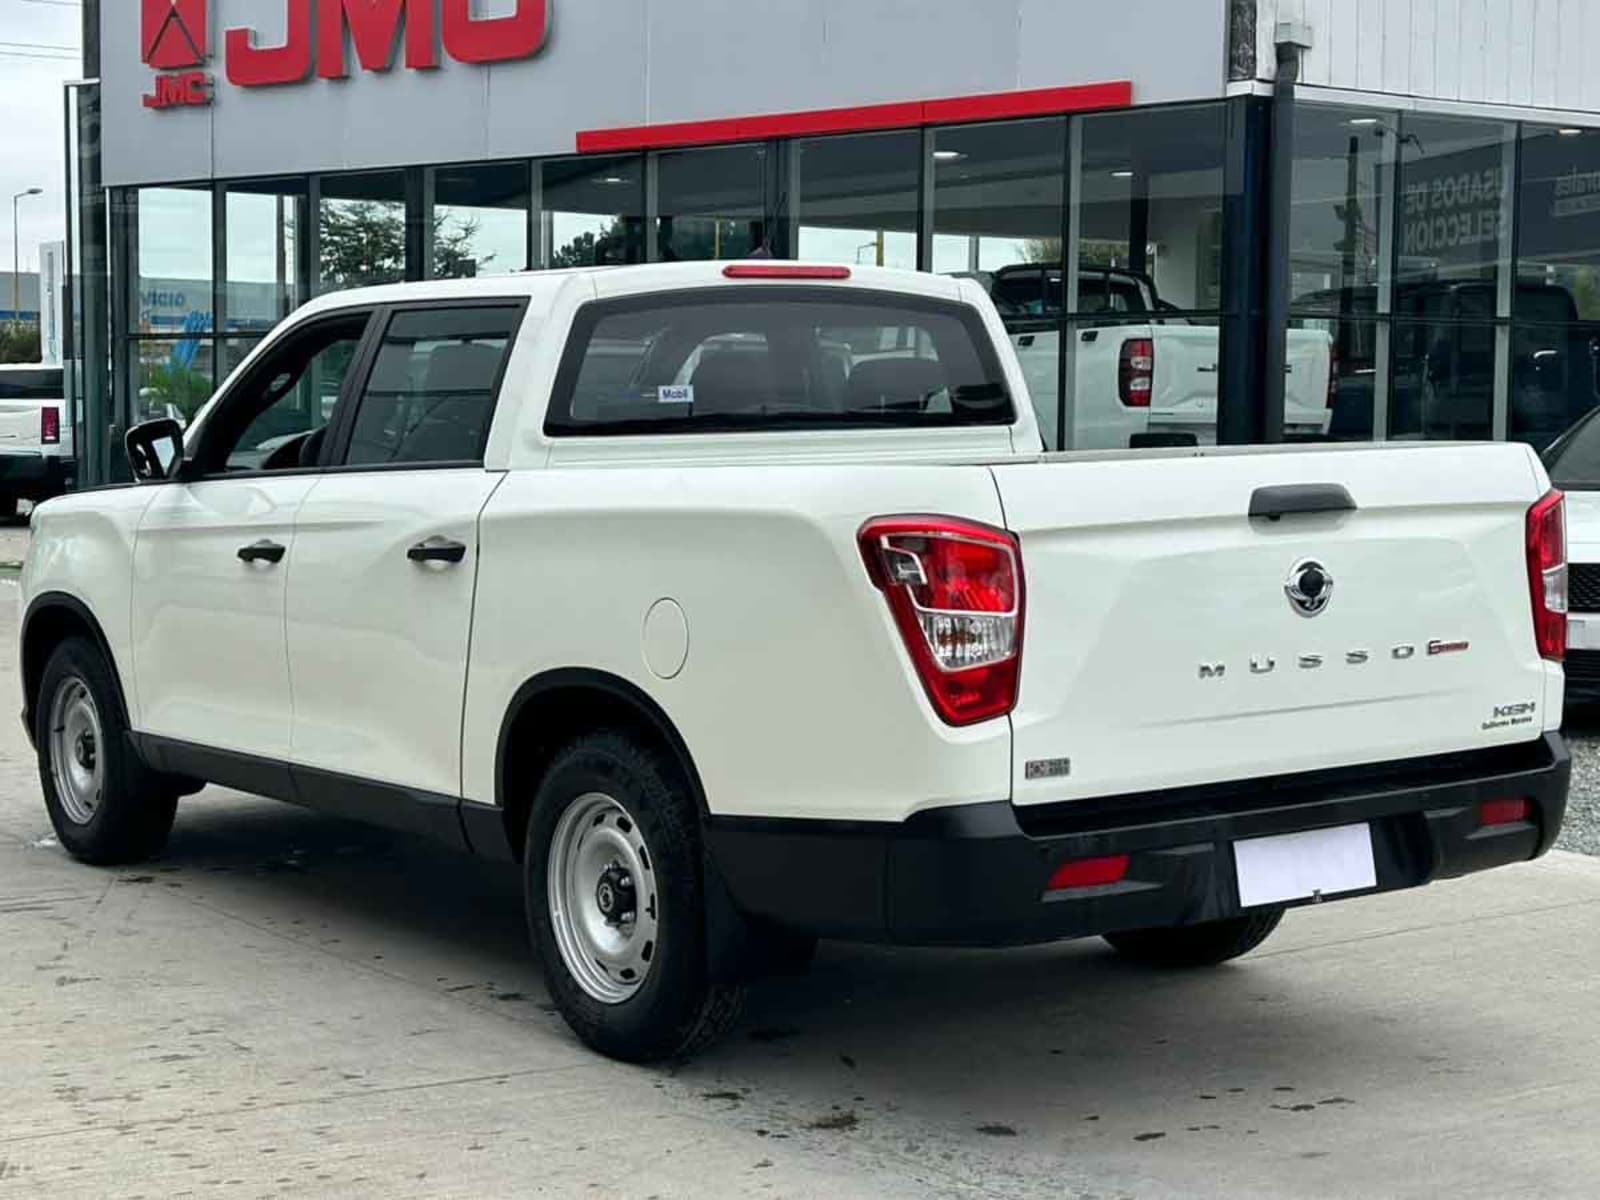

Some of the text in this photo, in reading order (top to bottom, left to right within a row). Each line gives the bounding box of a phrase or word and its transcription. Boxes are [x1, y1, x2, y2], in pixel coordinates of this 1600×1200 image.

[142, 71, 208, 108] JMC
[661, 388, 689, 399] Mobil
[1198, 645, 1415, 679] MUSSO
